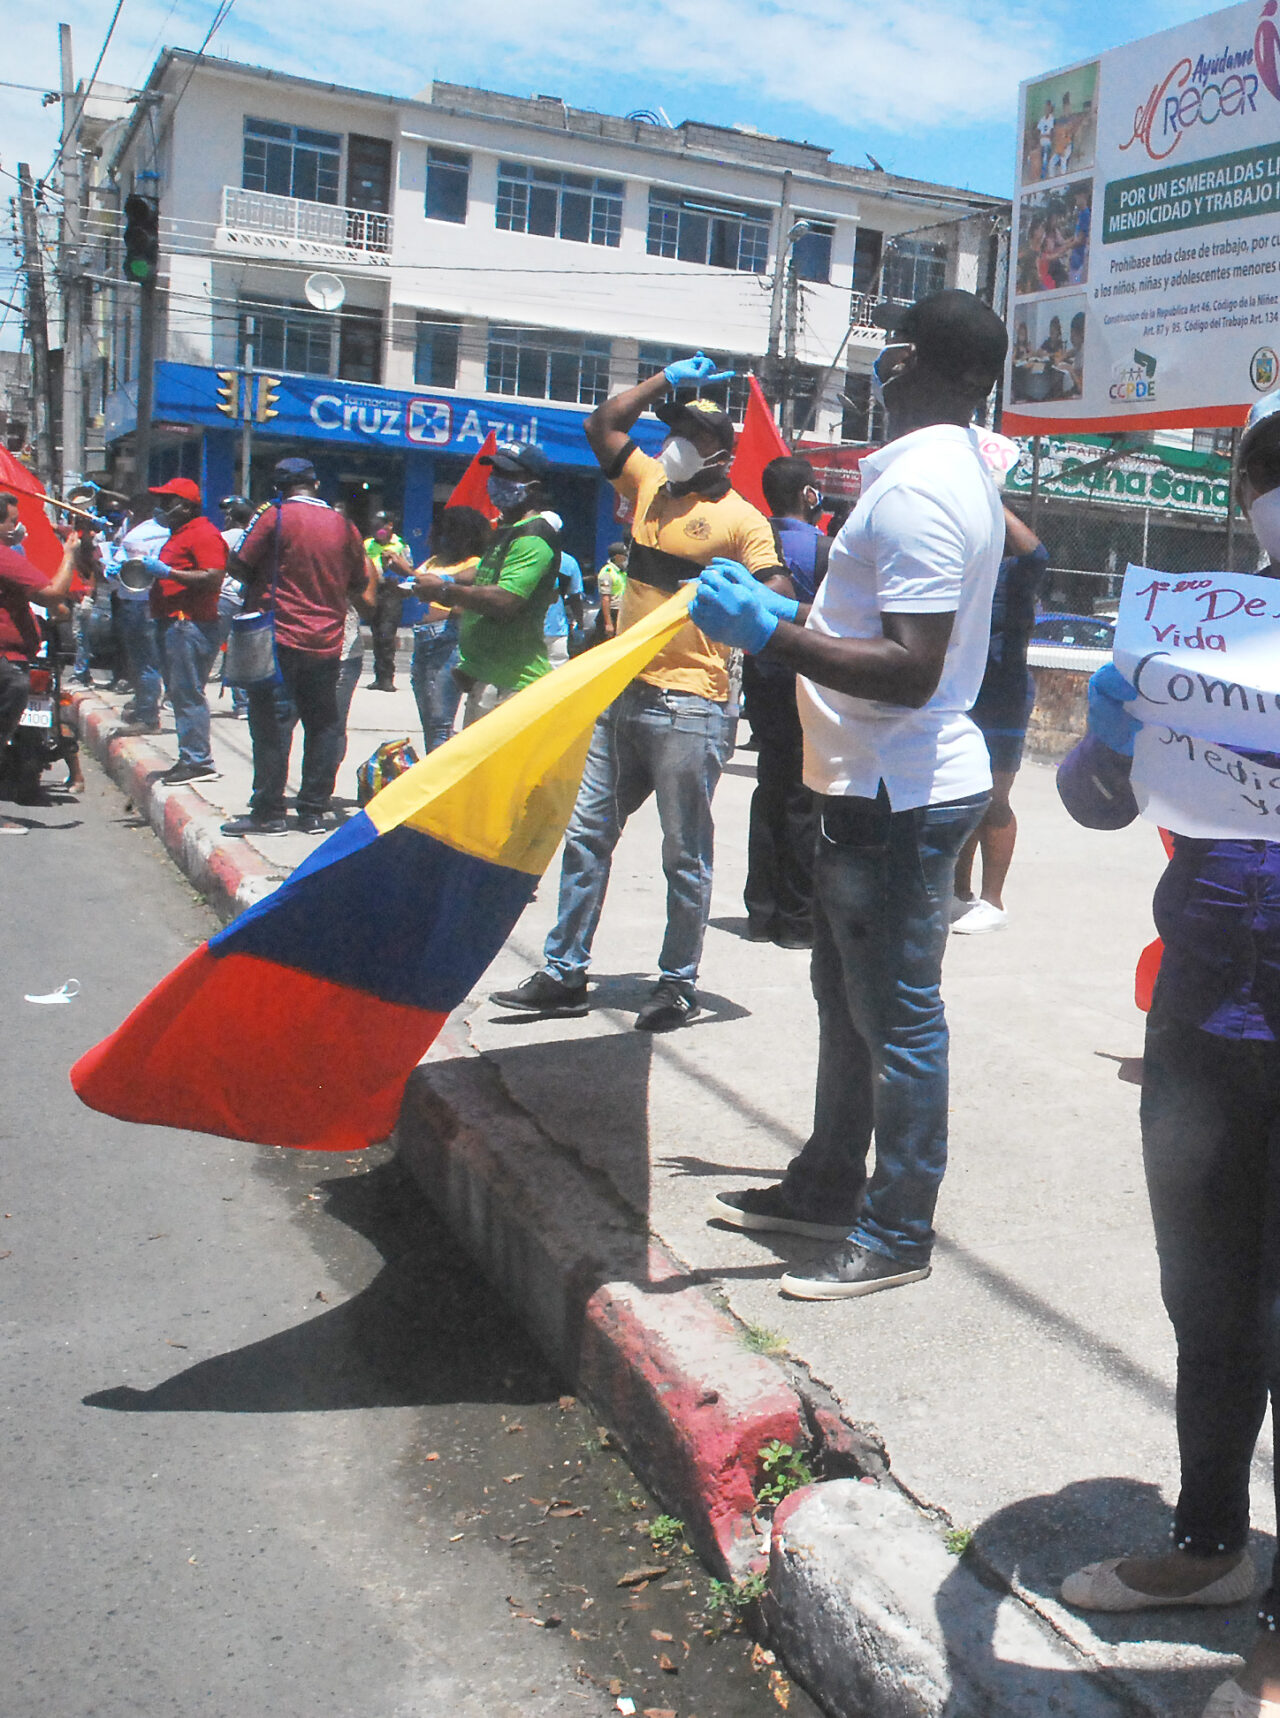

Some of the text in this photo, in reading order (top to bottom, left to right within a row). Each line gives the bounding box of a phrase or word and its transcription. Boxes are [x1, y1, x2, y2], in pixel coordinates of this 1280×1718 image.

[1191, 46, 1254, 87] Ayúdame
[1120, 188, 1145, 208] POR
[1148, 182, 1168, 201] UN
[1170, 159, 1264, 197] ESMERALDAS
[1109, 200, 1190, 232] MENDICIDAD
[1193, 197, 1204, 215] Y
[1205, 184, 1272, 213] TRABAJO
[1152, 249, 1172, 266] toda
[1174, 246, 1197, 262] clase
[1198, 242, 1210, 258] de
[1212, 237, 1249, 257] trabajo,
[1251, 237, 1269, 253] por
[1100, 283, 1112, 298] los
[1163, 278, 1170, 292] y
[1170, 269, 1231, 288] adolescentes
[1233, 260, 1276, 277] menores
[1109, 381, 1155, 399] CCPDE
[310, 394, 538, 444] Cruz Azul
[1151, 470, 1230, 507] Sana
[1195, 588, 1267, 622] De
